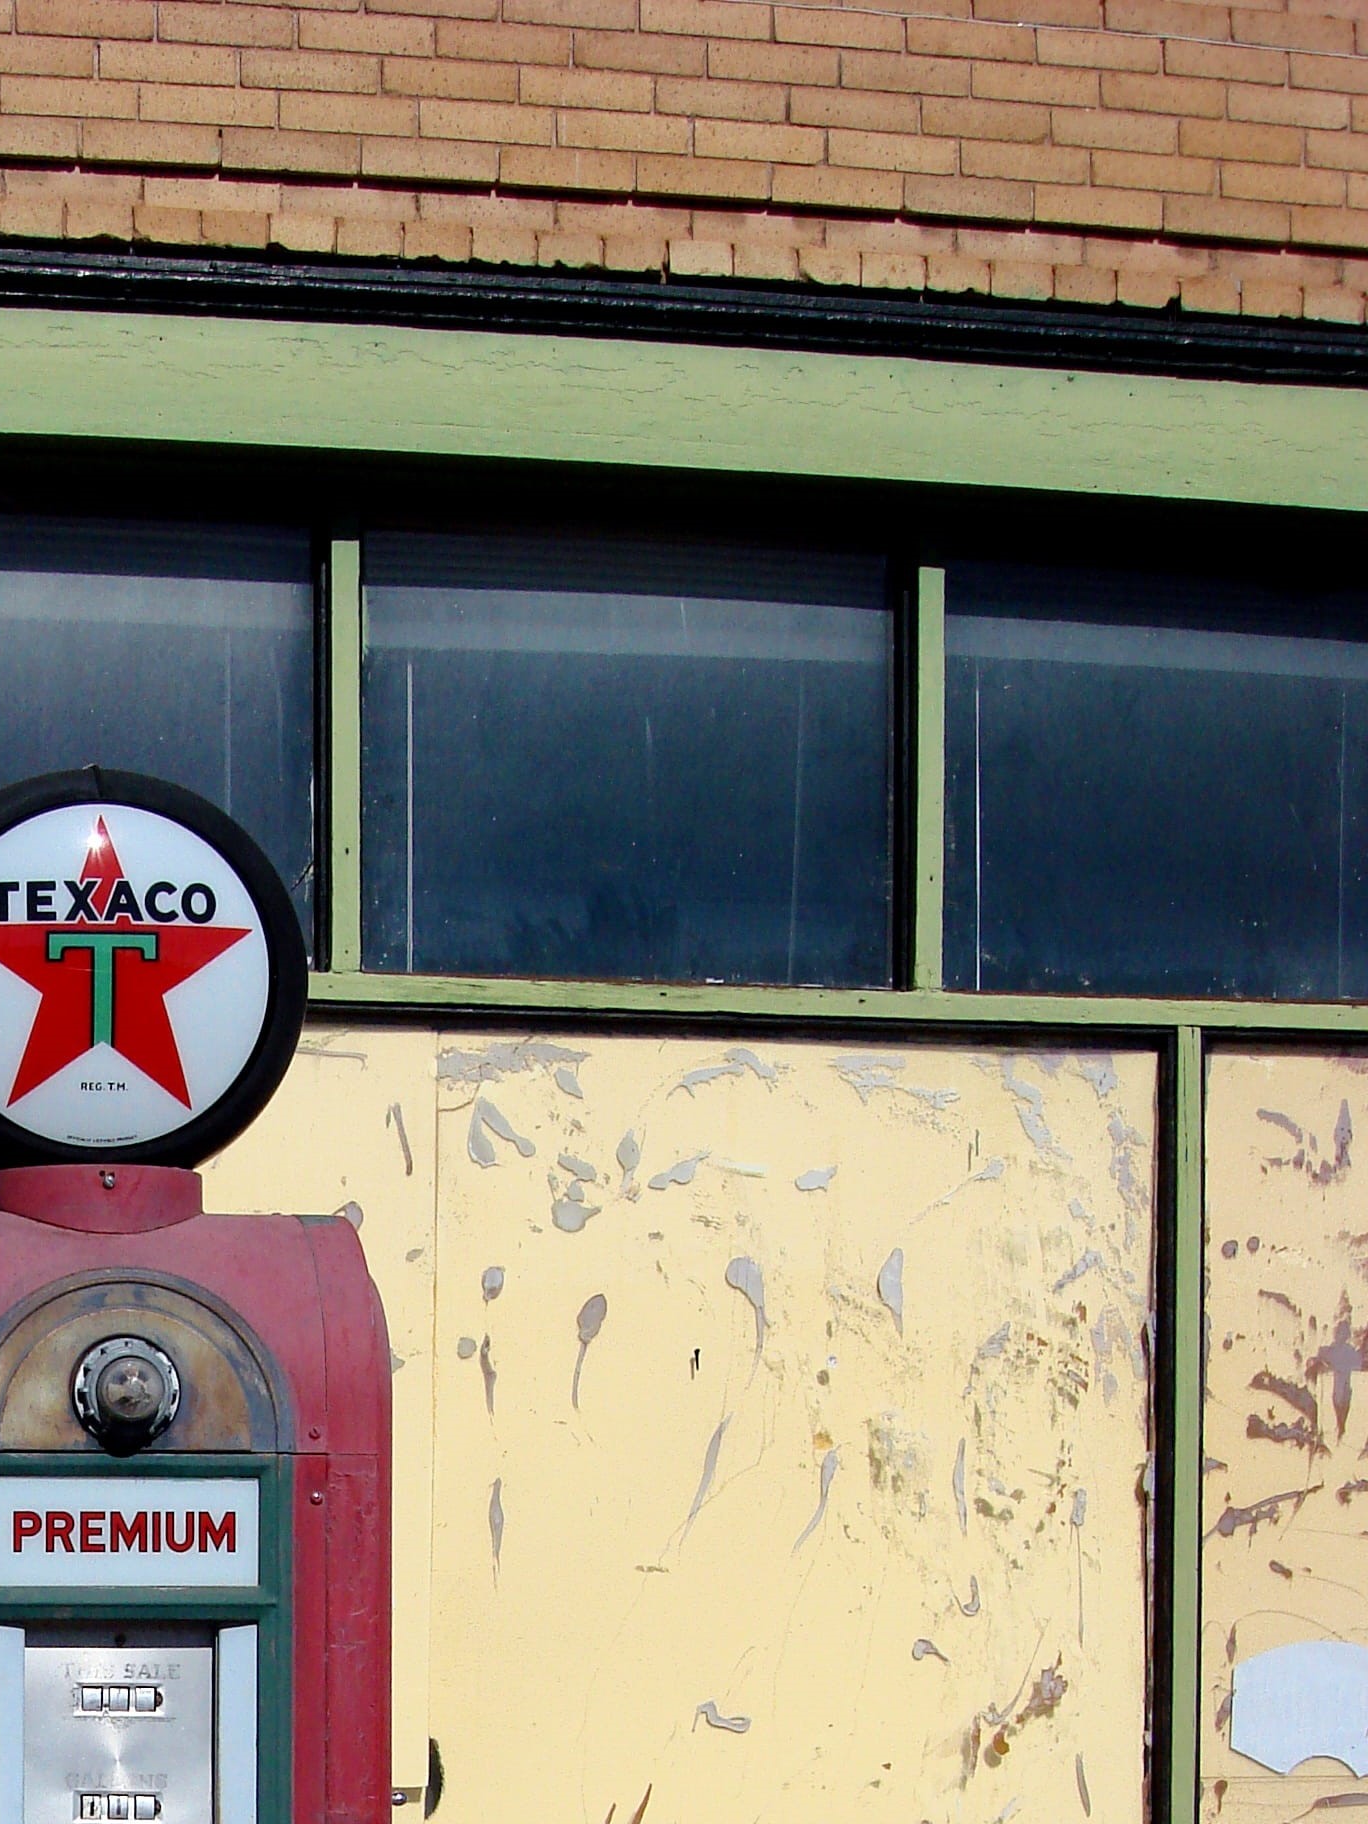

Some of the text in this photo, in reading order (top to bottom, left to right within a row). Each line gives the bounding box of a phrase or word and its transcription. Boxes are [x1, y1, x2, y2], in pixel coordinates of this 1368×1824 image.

[44, 929, 161, 1049] T
[80, 1081, 105, 1092] REG.
[12, 1510, 237, 1554] PREMIUM
[123, 1663, 181, 1680] SALE
[64, 1773, 169, 1789] GALNS
